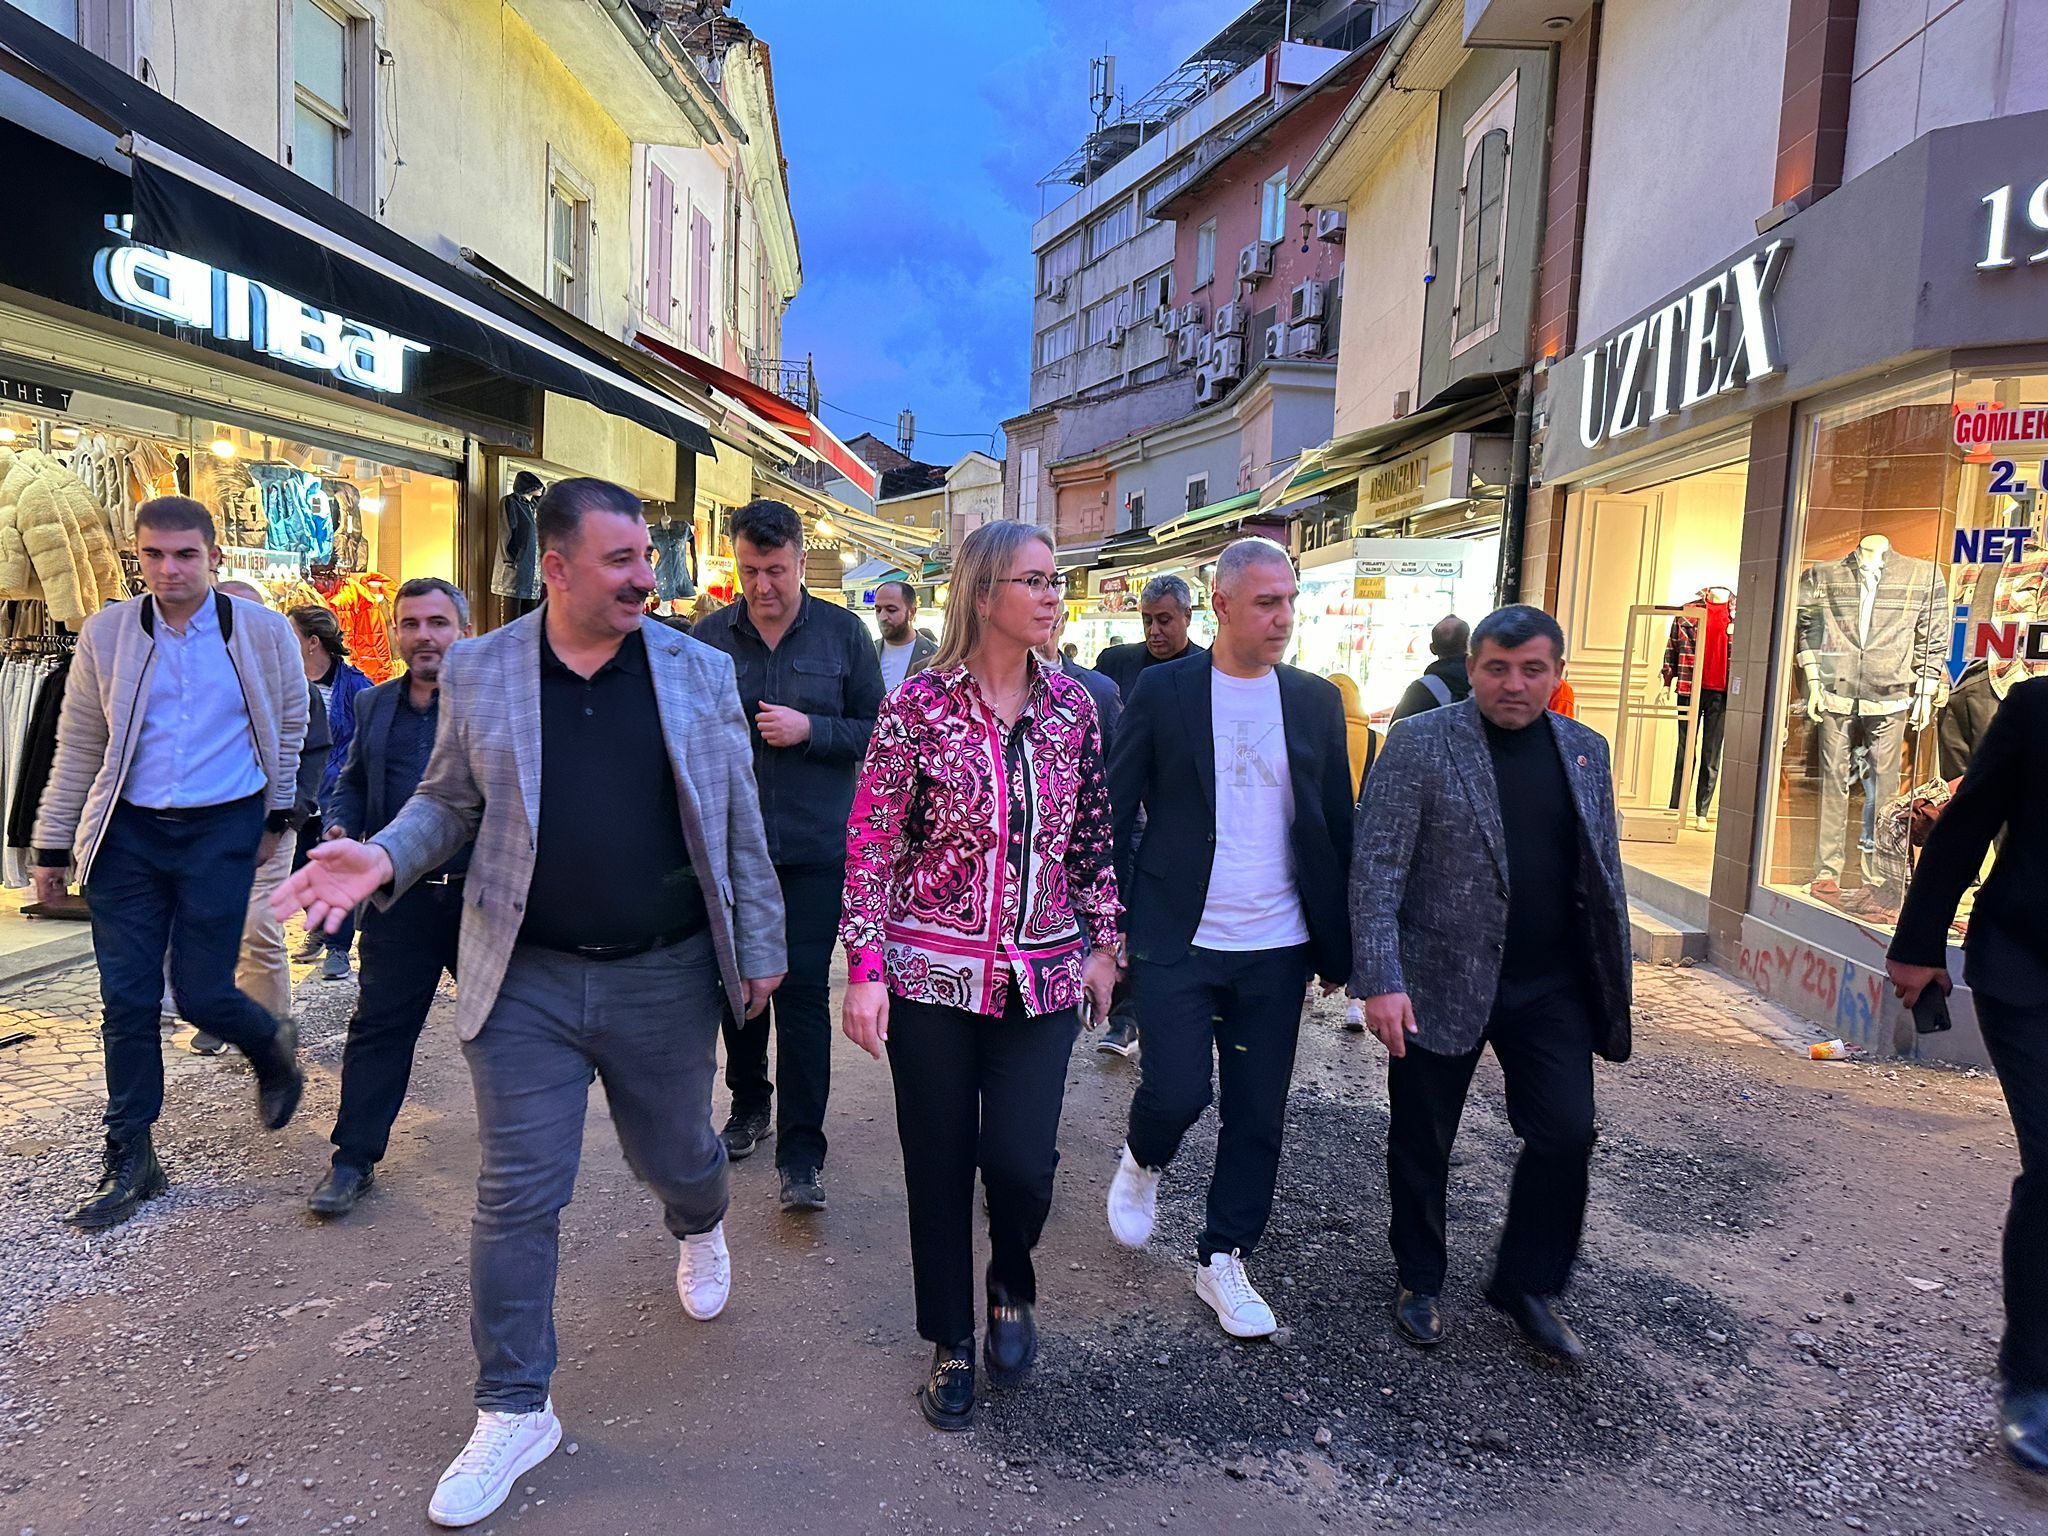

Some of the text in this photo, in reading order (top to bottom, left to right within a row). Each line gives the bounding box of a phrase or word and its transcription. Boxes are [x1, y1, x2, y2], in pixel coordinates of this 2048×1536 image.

[1580, 239, 1783, 449] UZTEX
[0, 379, 43, 404] THE
[1988, 460, 2025, 493] 2.
[1953, 529, 2032, 563] NET
